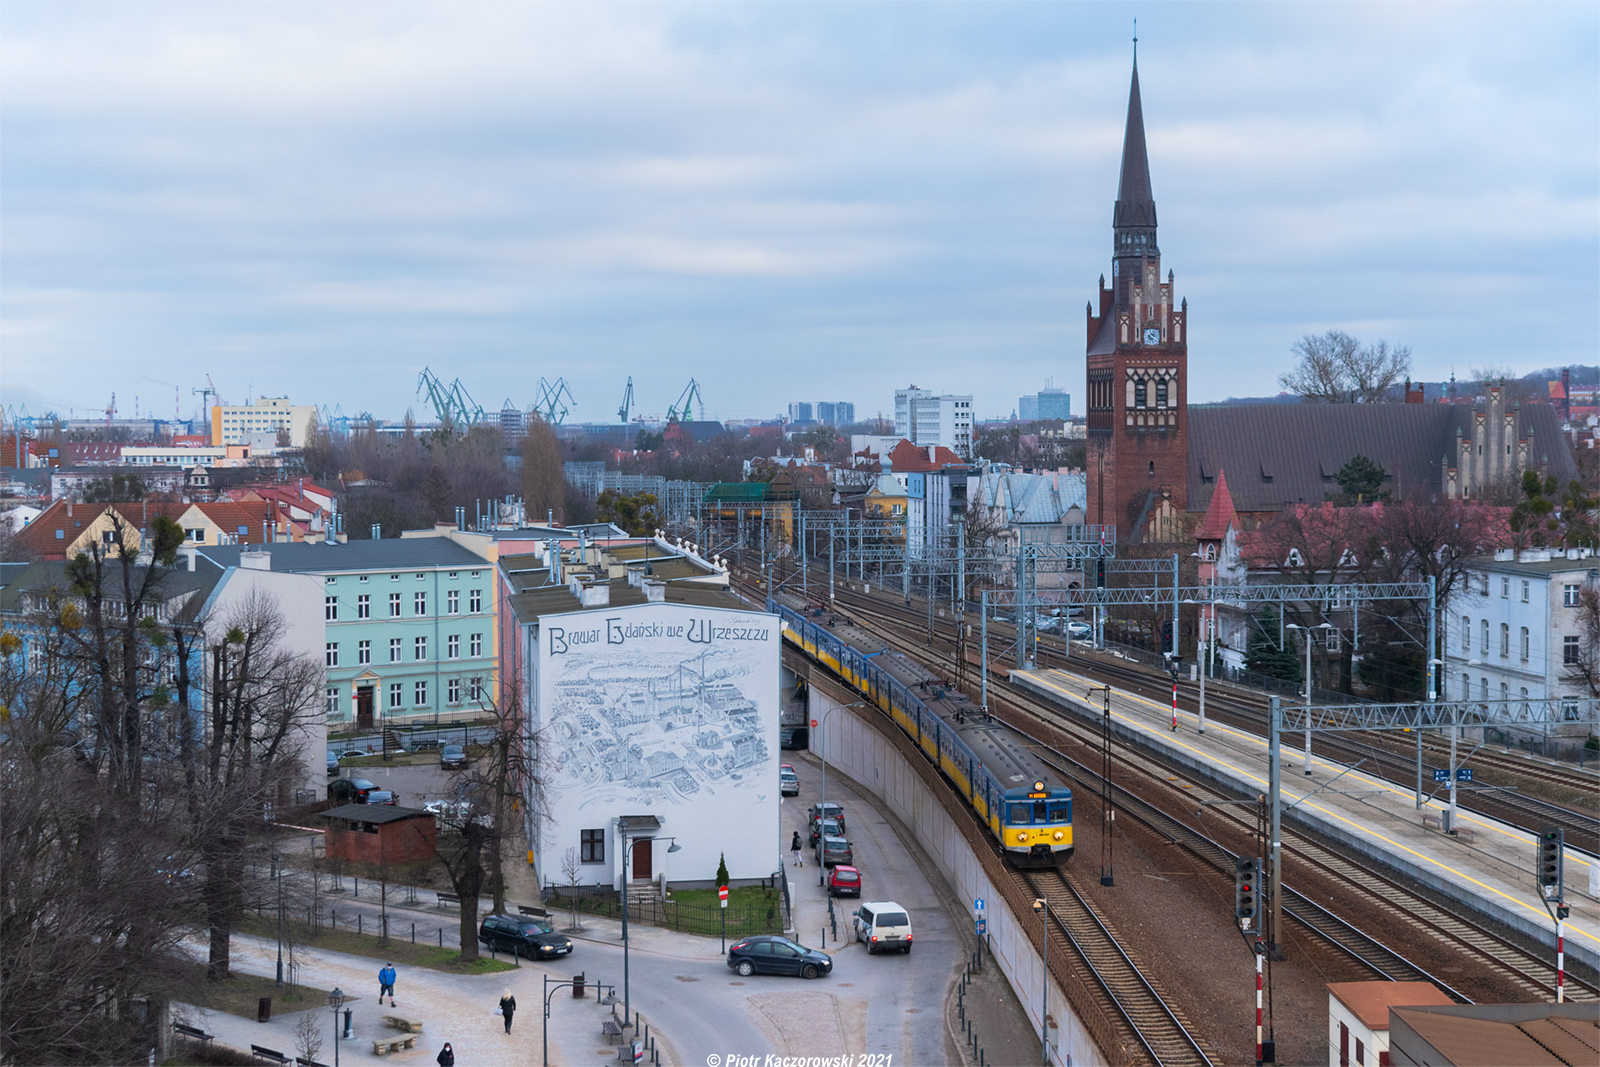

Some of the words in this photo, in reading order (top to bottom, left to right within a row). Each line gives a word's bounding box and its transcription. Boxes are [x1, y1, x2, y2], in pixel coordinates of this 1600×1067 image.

[548, 627, 600, 656] Browar
[605, 617, 664, 645] Gdański
[666, 625, 683, 638] we
[687, 619, 769, 644] Wrzeszczu
